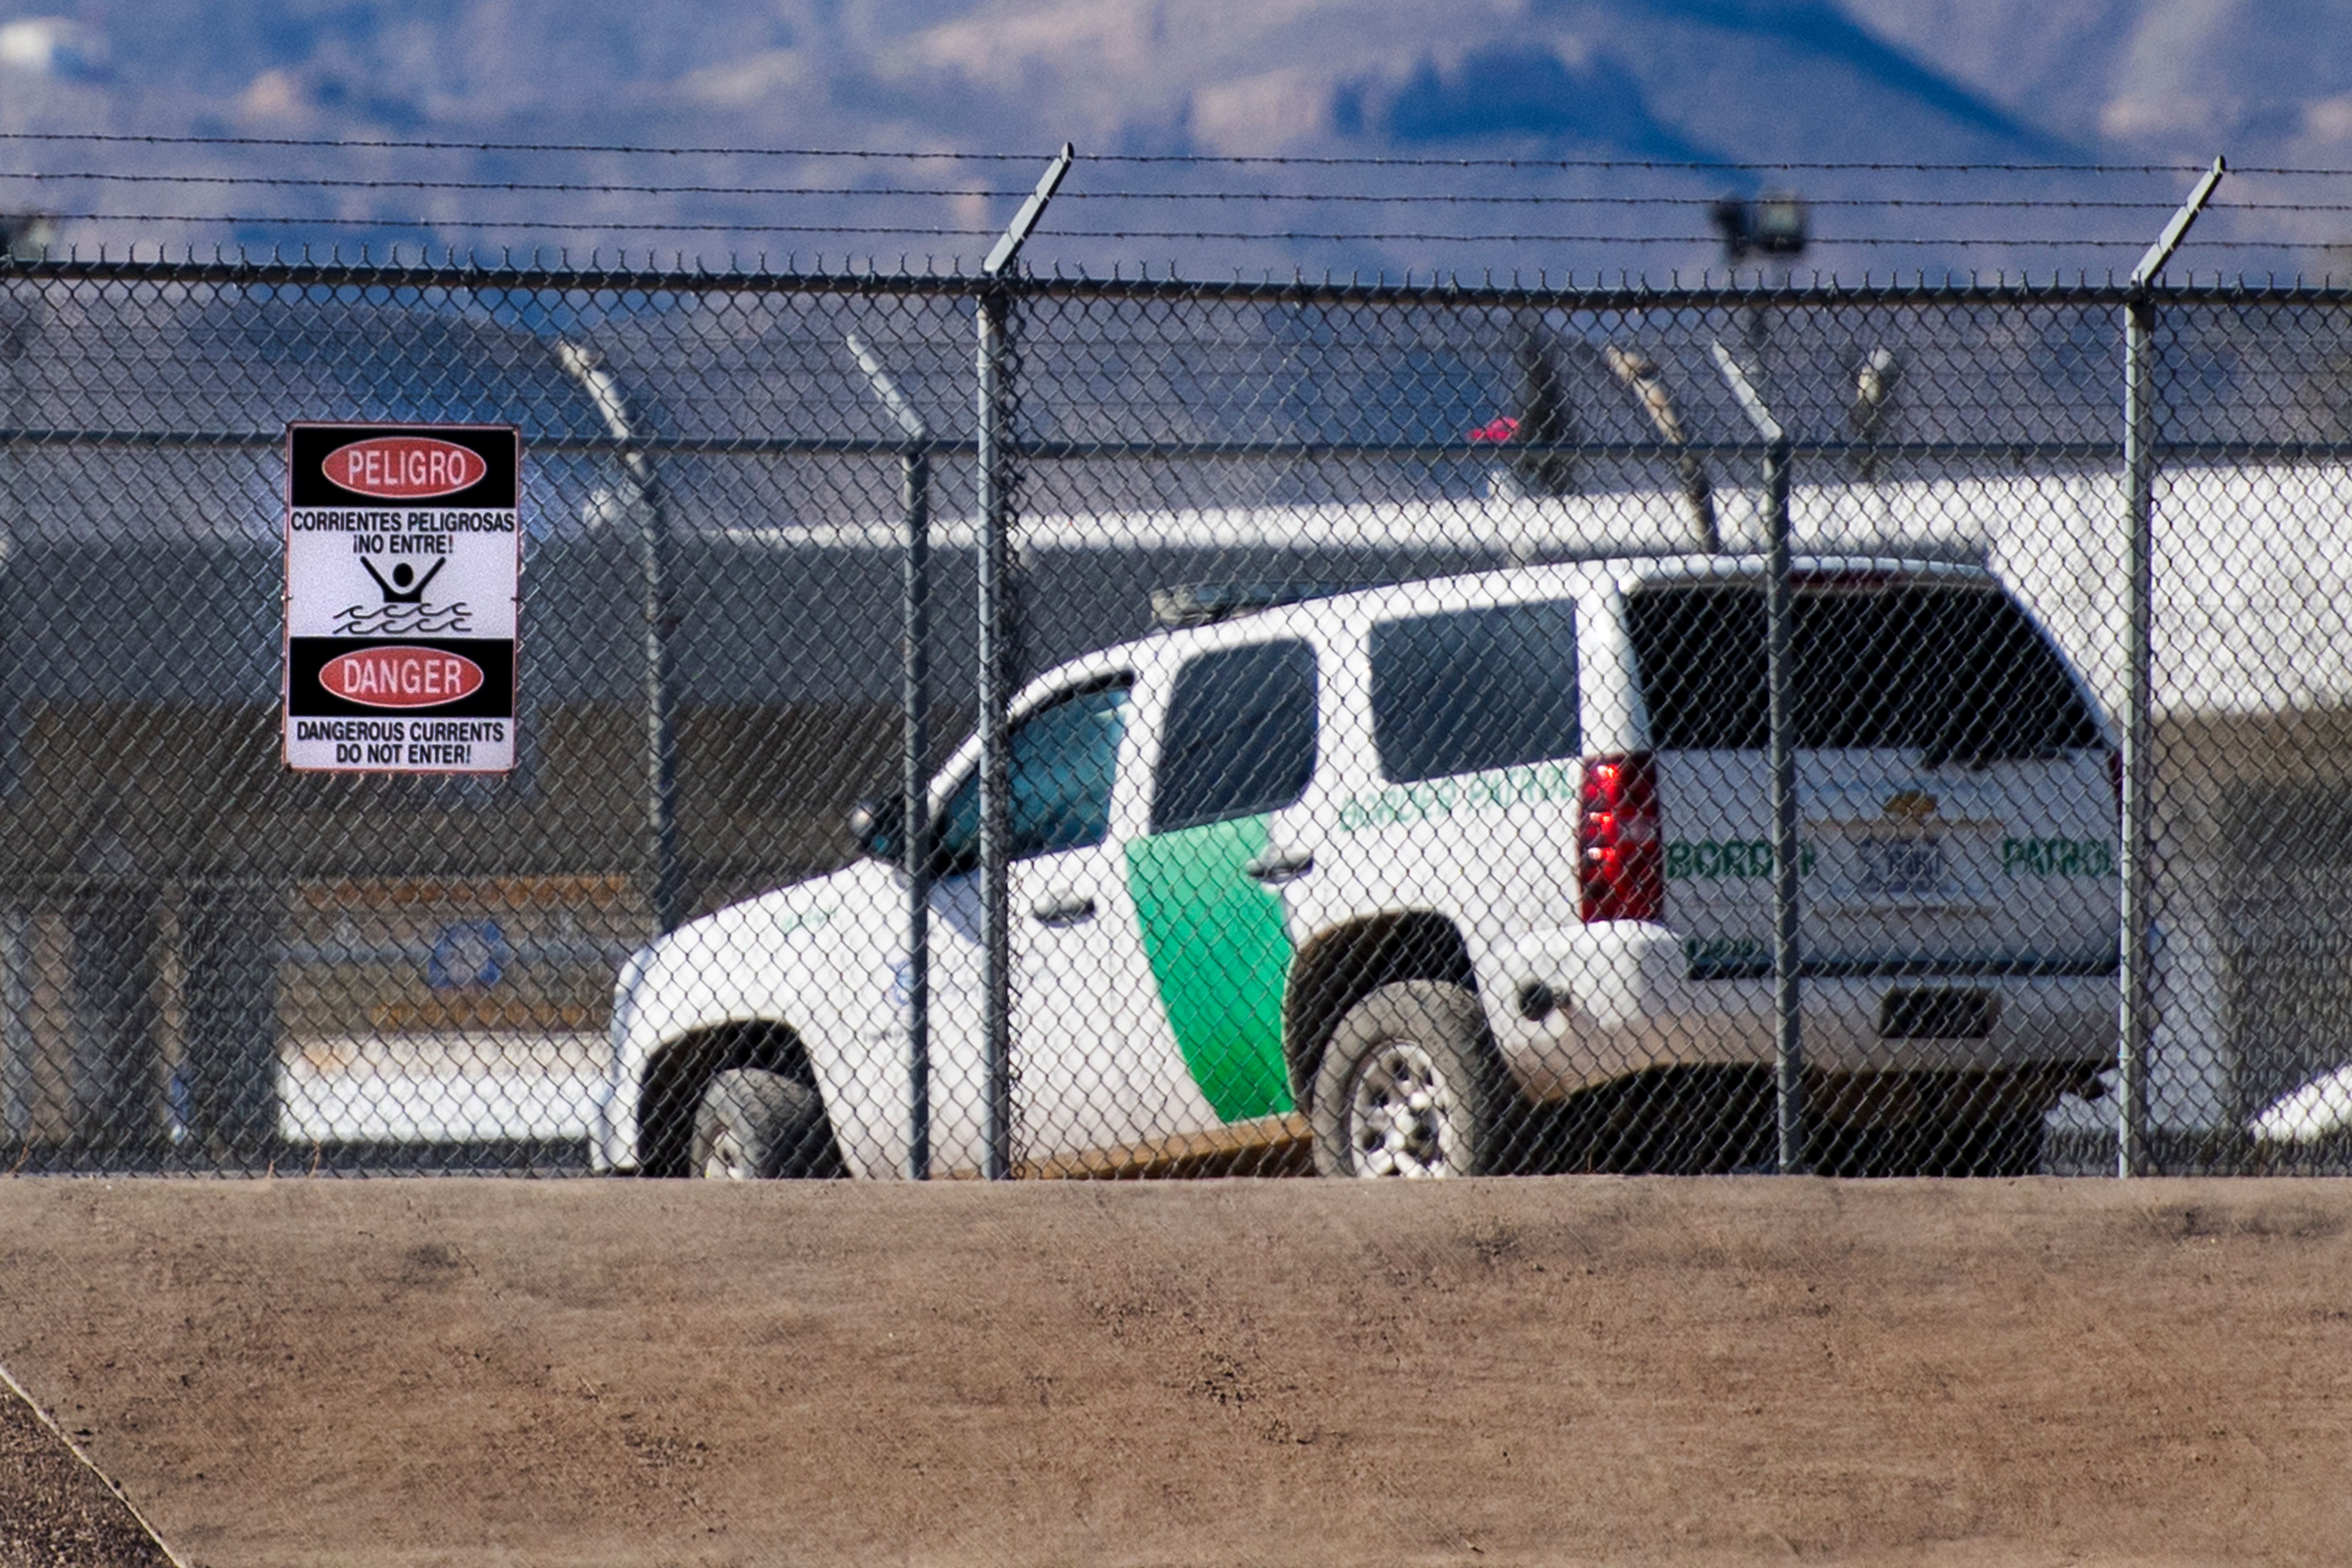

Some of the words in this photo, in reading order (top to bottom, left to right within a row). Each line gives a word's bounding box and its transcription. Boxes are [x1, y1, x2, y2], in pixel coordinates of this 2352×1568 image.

[348, 450, 466, 486] PELIGRO
[291, 512, 402, 531] CORRIENTES
[407, 512, 515, 532] PELIGROSAS
[353, 534, 384, 554] ¡NO
[389, 534, 453, 554] ENTRE!
[343, 659, 462, 694] DANGER
[297, 721, 404, 741] DANGEROUS
[410, 722, 504, 742] CURRENTS
[336, 743, 362, 763] DO
[367, 744, 403, 763] NOT
[408, 745, 471, 764] ENTER!
[1667, 838, 1816, 878] BORDR
